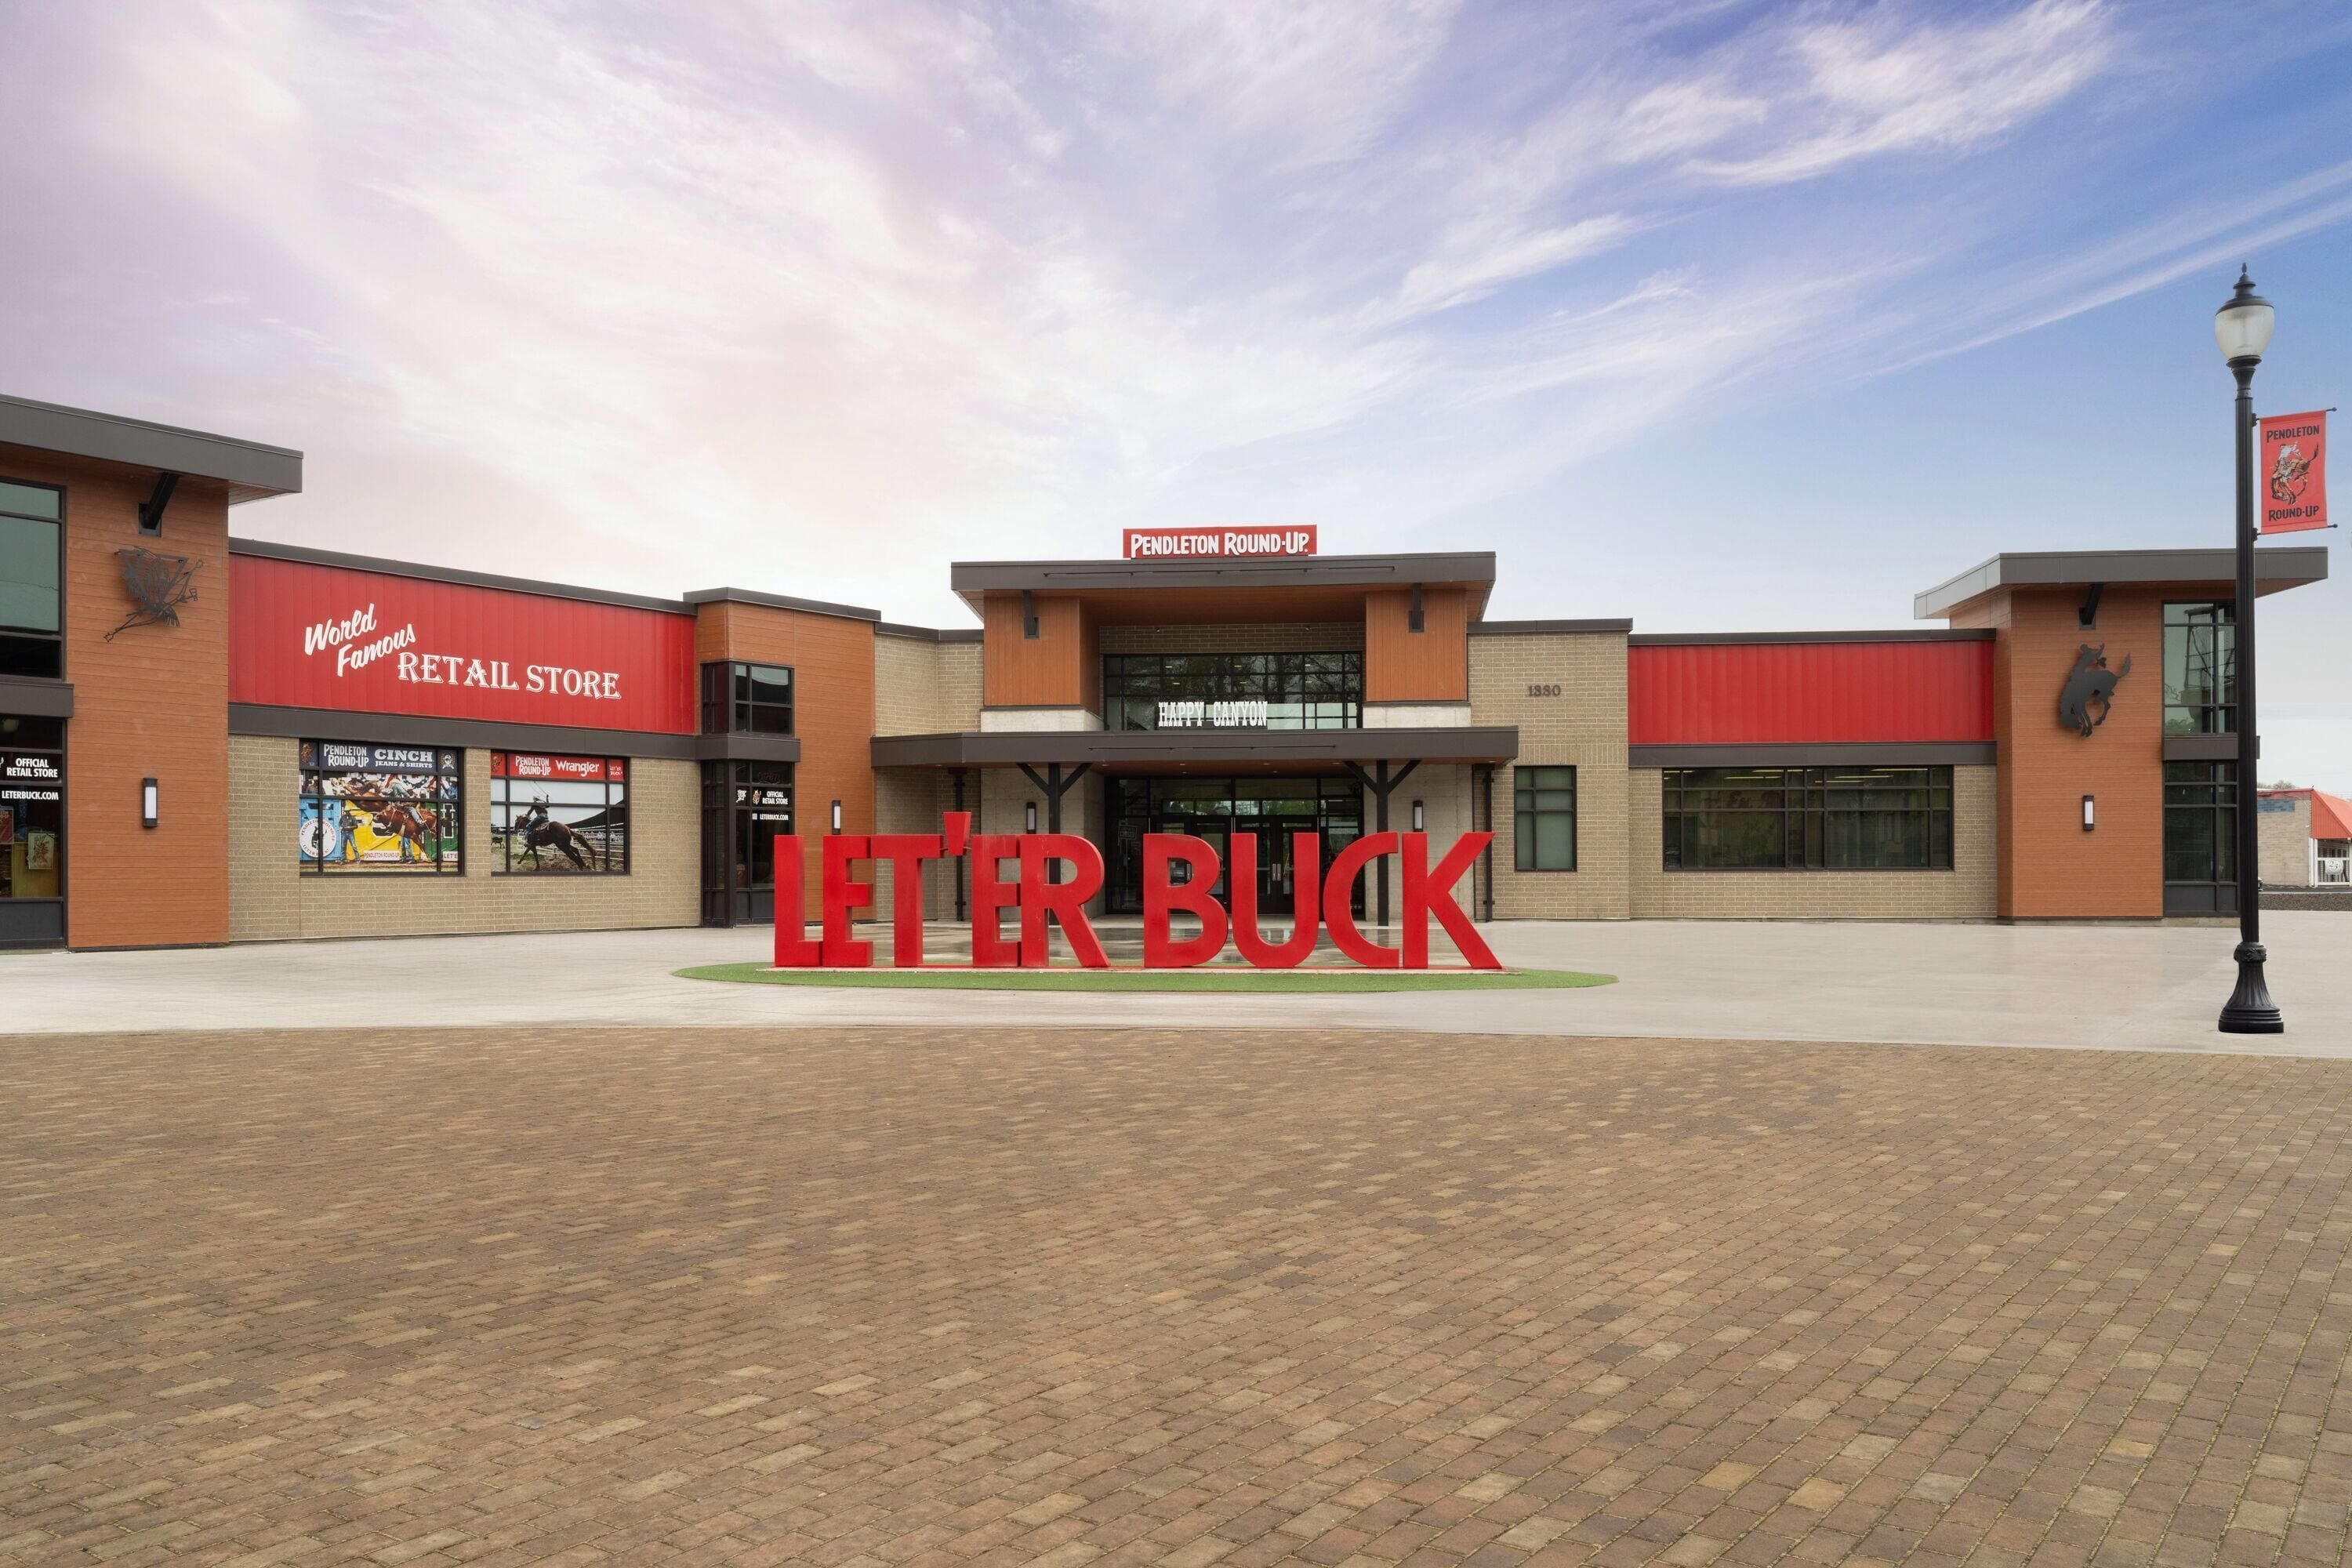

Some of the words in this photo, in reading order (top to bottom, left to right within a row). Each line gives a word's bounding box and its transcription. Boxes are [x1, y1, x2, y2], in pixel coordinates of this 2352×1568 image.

[2266, 425, 2320, 443] PENDLETON
[2268, 505, 2320, 521] ROUND-UP
[1131, 534, 1219, 557] PENDLETON
[304, 603, 377, 656] World
[337, 624, 416, 677] Famous
[397, 652, 519, 691] RETAIL
[525, 664, 622, 699] STORE
[1158, 702, 1204, 728] HAPPY
[1213, 701, 1268, 727] CANYON
[323, 743, 367, 757] PENDLETON
[374, 749, 433, 762] CINCH
[16, 757, 49, 768] OFFICIAL
[328, 754, 369, 768] ROUND-UP
[515, 755, 549, 767] PENDLETON
[555, 760, 599, 777] Wrangler
[6, 767, 32, 777] RETAIL
[33, 768, 58, 778] STORE
[519, 765, 551, 775] ROUND-UP
[2, 790, 59, 800] LETERBUCK.COM
[775, 811, 1110, 967] LET'ER
[1144, 831, 1503, 968] BUCK
